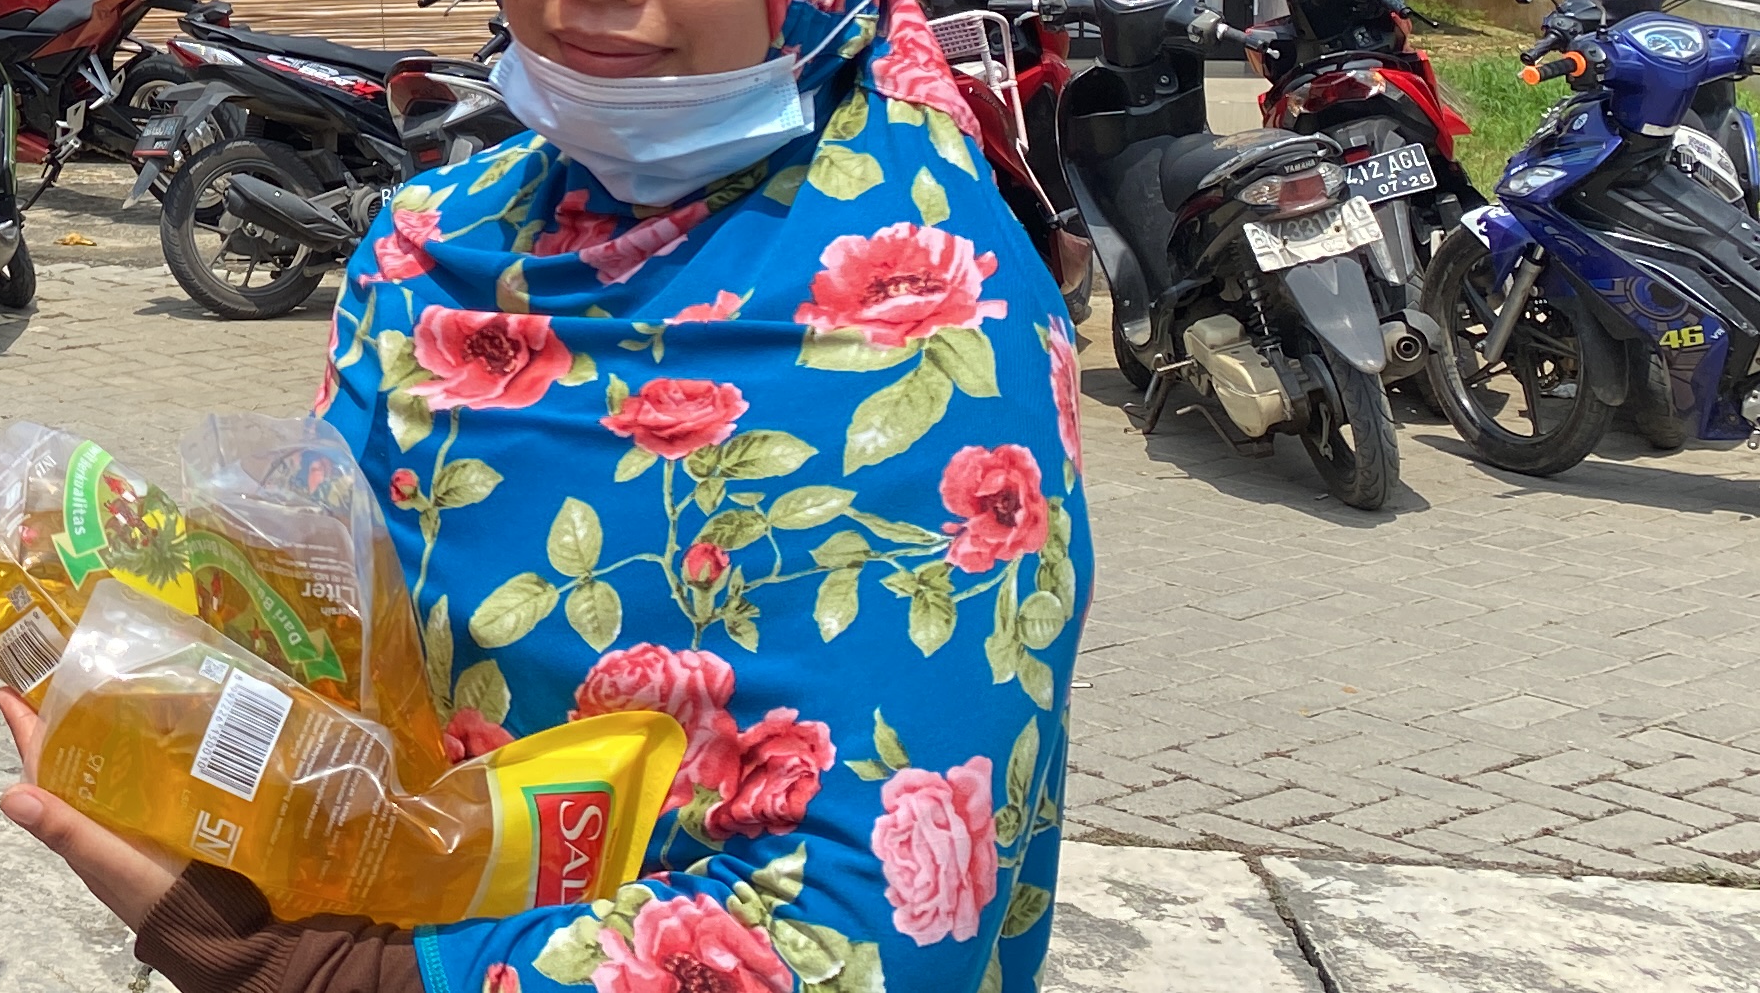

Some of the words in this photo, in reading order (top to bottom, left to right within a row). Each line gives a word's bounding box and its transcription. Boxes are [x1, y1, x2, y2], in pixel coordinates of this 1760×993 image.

[1283, 158, 1317, 174] YAMAHA
[1388, 148, 1427, 177] AGL
[1658, 324, 1705, 350] 46
[300, 582, 357, 607] Liter
[271, 608, 302, 646] Dari
